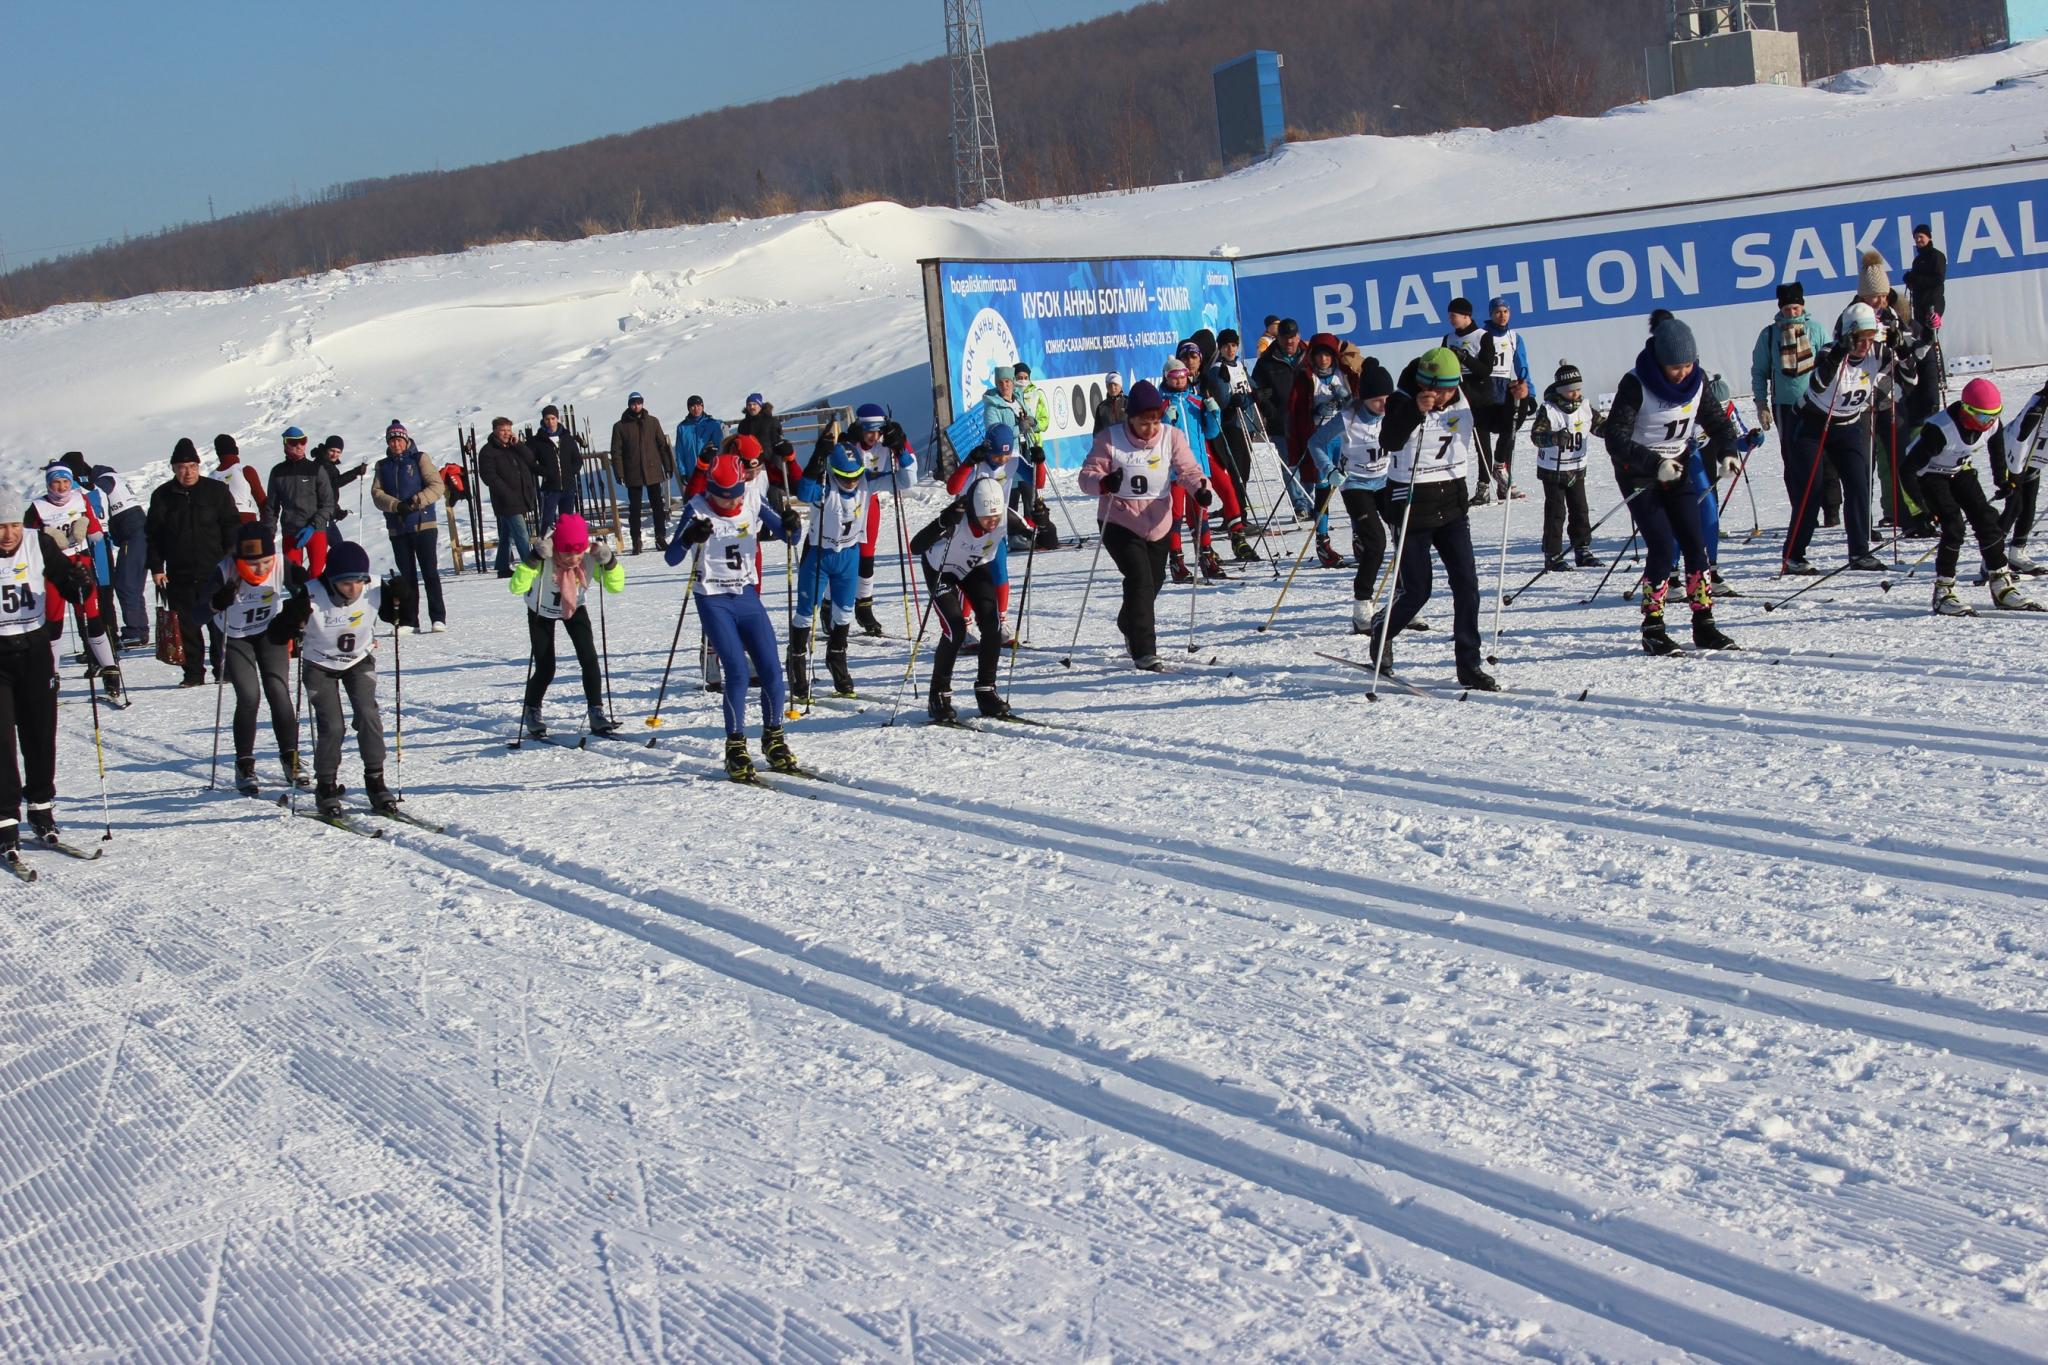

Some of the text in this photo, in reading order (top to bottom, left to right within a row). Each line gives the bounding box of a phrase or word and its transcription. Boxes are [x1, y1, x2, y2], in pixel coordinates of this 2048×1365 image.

[1312, 200, 2048, 336] BIATHLON SAKHAL
[950, 275, 1016, 297] bogaliskimircup.ru
[1021, 291, 1061, 319] КУБОК
[1064, 289, 1097, 316] АННЫ
[1099, 281, 1148, 315] БОГАЛИЙ
[973, 316, 995, 345] АННЫ
[1045, 336, 1102, 354] ЮЖНО-САХАЛИНСК,
[1102, 333, 1129, 350] ВЕНСКАЯ,
[1841, 389, 1867, 407] 13
[1664, 418, 1690, 441] 17
[1435, 435, 1453, 460] 7
[1130, 474, 1148, 495] 9
[983, 497, 1001, 508] DNB
[725, 543, 743, 571] 5
[2, 582, 36, 614] 54
[242, 605, 271, 624] 15
[337, 632, 356, 653] 6
